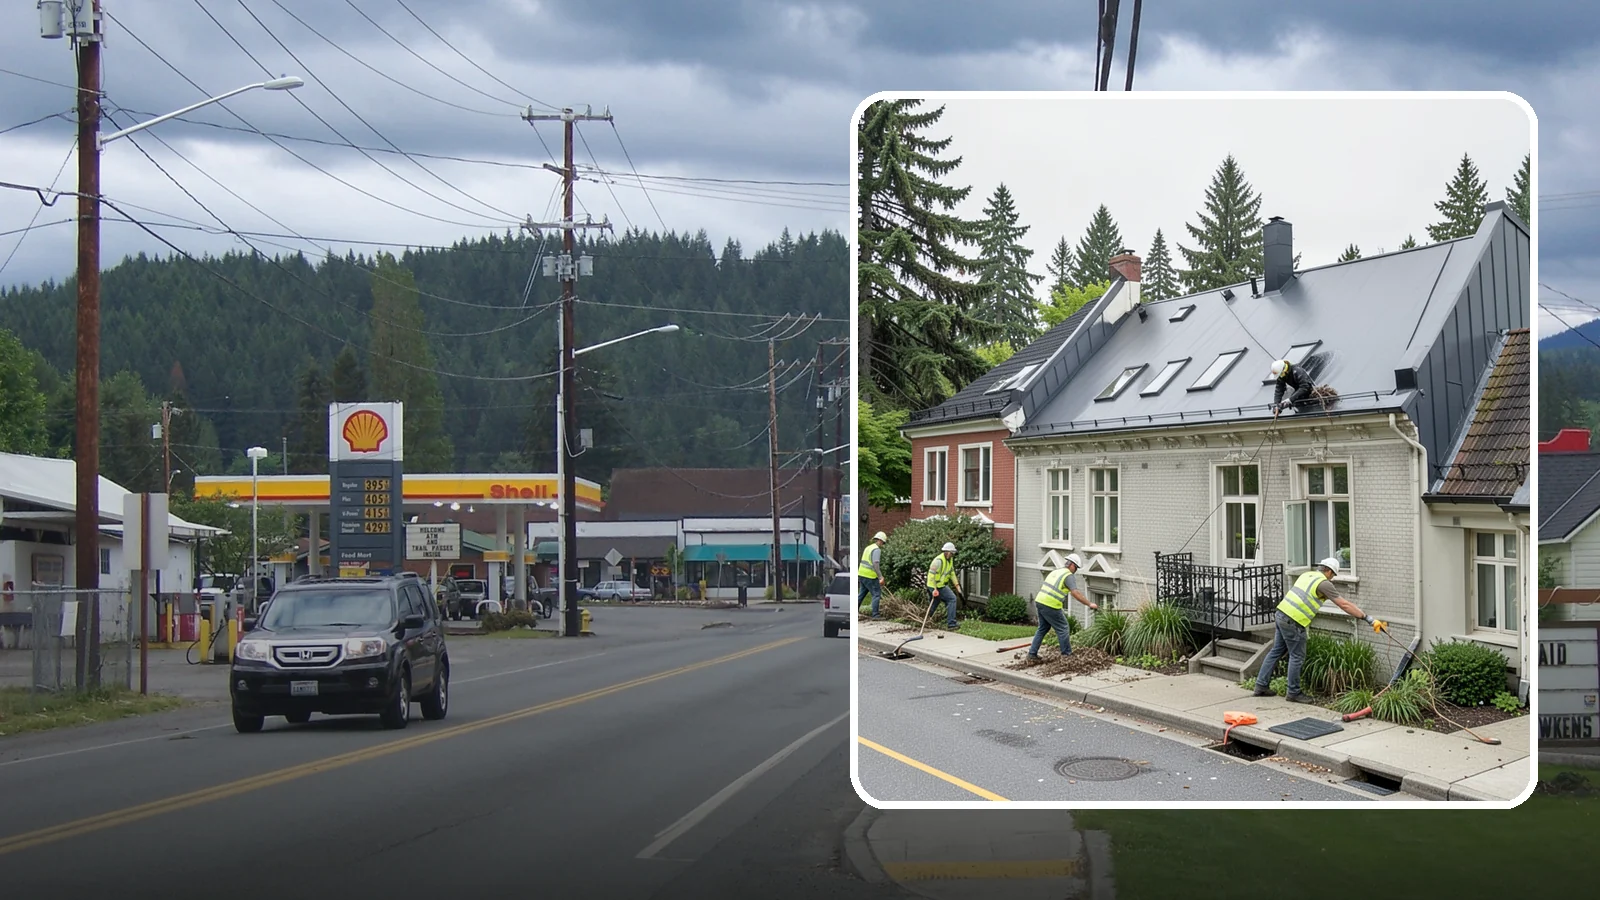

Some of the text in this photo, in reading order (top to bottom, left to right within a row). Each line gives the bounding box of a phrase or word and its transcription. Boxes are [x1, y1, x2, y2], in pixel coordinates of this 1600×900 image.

[366, 480, 383, 491] 395
[490, 484, 547, 499] Shell
[366, 494, 383, 504] 405
[366, 508, 383, 518] 415
[366, 523, 383, 532] 429
